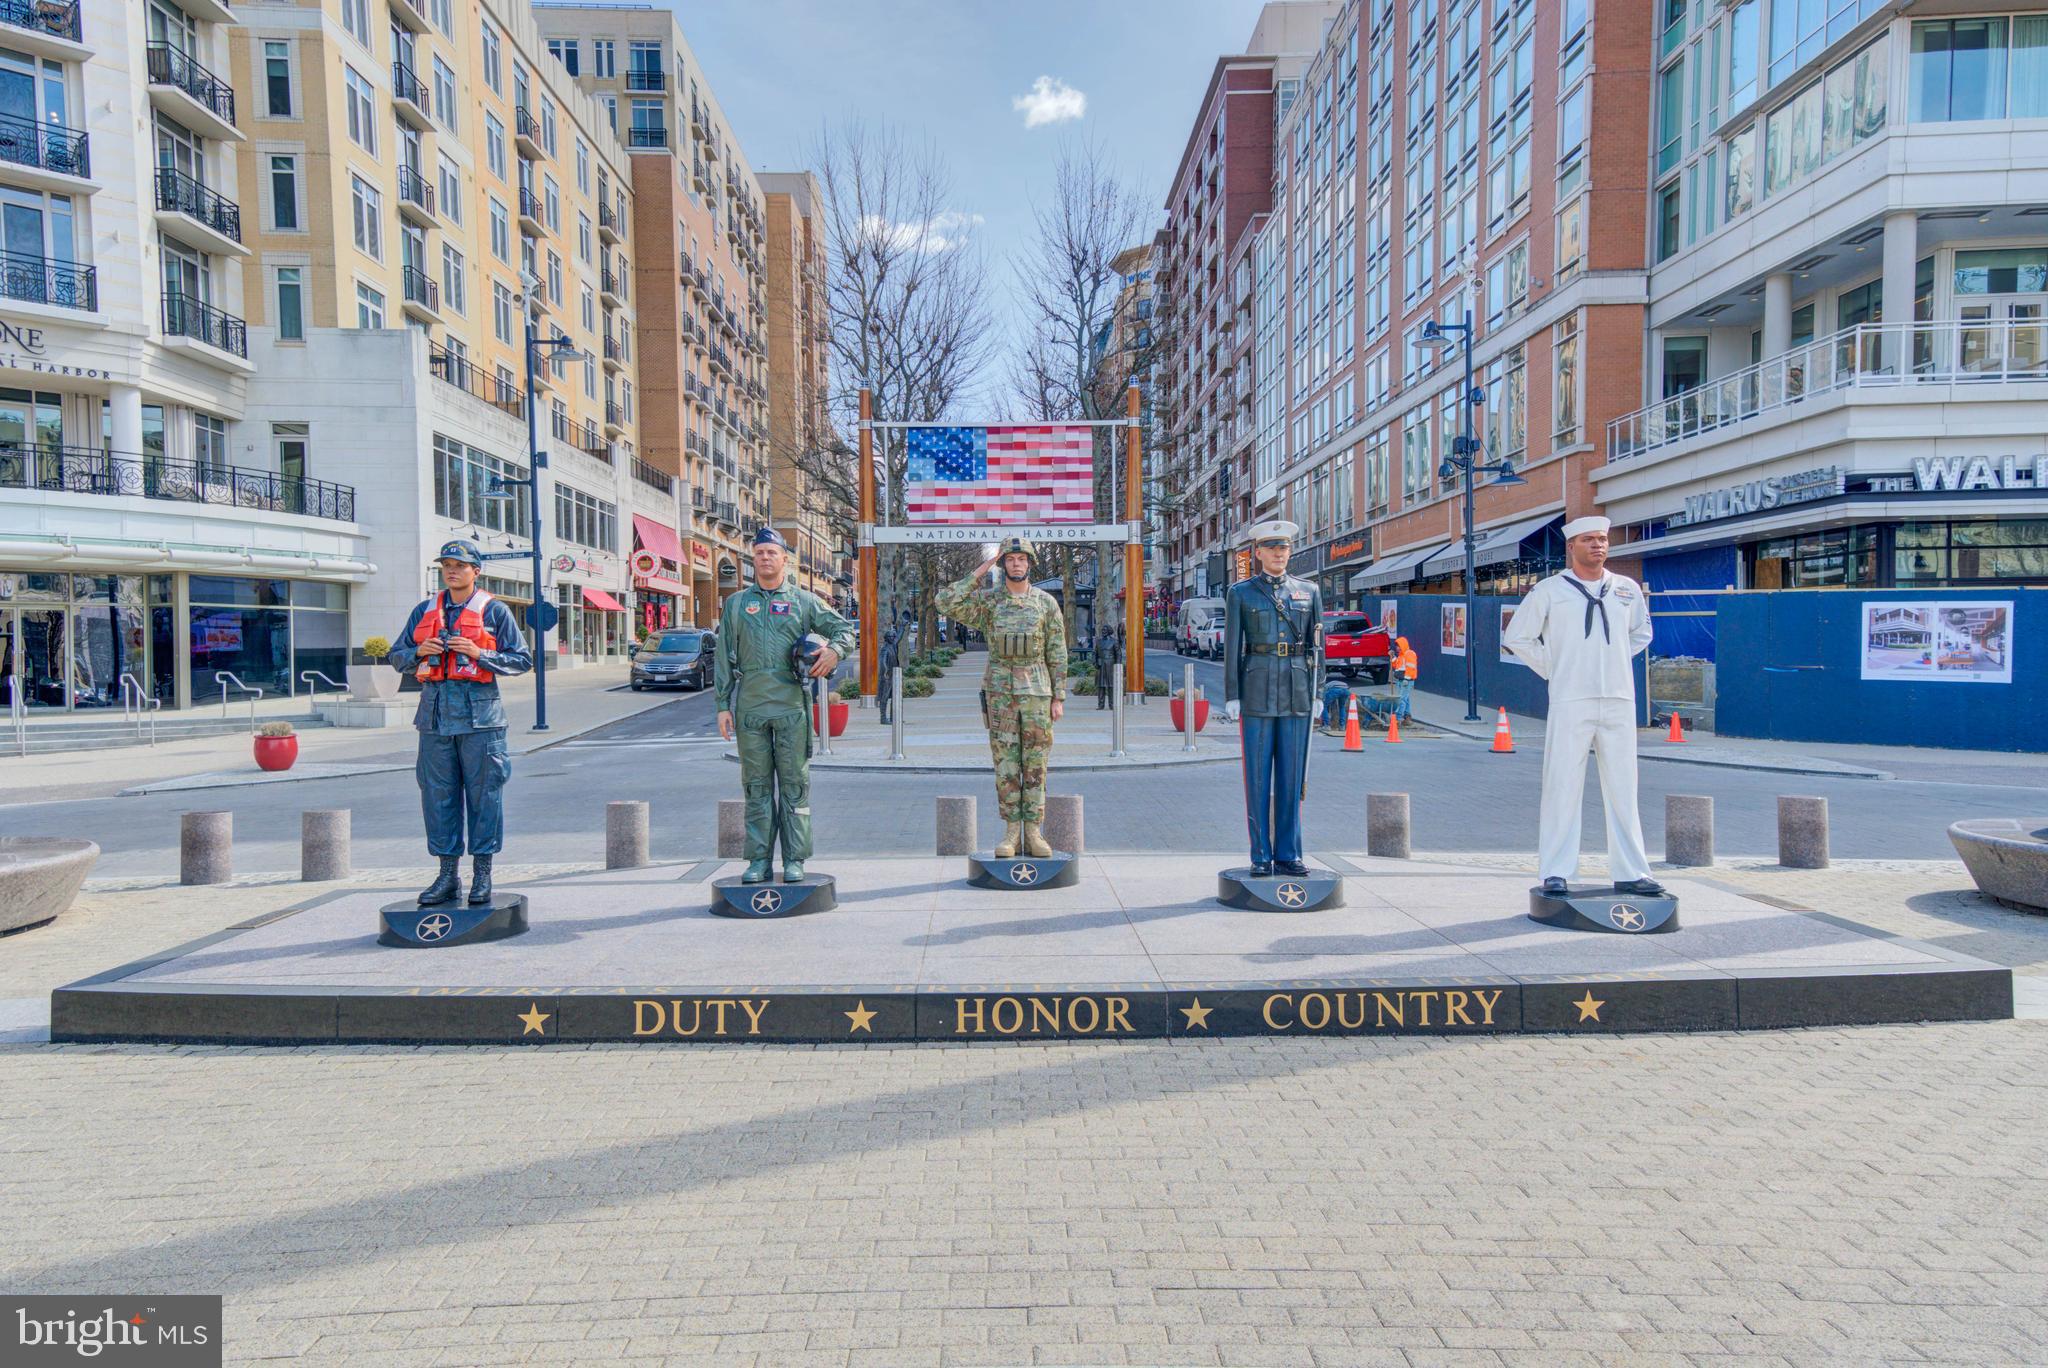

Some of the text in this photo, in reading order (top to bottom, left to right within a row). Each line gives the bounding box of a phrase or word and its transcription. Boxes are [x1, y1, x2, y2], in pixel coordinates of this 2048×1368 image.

[0, 321, 46, 355] NE
[33, 361, 111, 380] HARBOR
[1866, 476, 1916, 493] THE
[1685, 476, 1778, 523] WALRUS
[914, 528, 1087, 540] NATIONAL HARBOR
[1262, 977, 1396, 990] YOUR
[632, 989, 1504, 1035] DUTY HONOR COUNTRY
